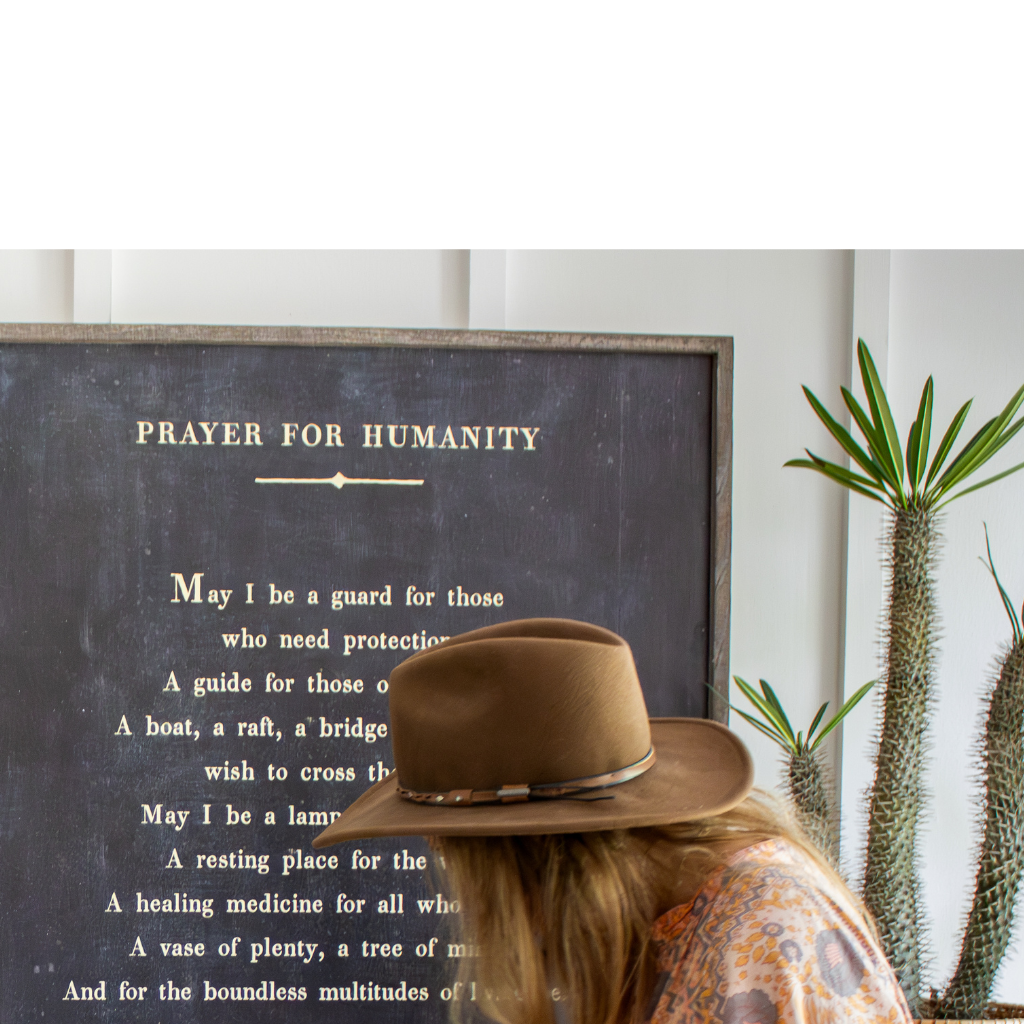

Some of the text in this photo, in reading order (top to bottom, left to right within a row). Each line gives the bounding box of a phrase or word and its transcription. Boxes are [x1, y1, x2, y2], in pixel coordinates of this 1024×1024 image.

[135, 420, 541, 451] PRAYER FOR HUMANITY
[169, 572, 504, 611] May I be a guard for those
[221, 626, 268, 649] who
[278, 628, 331, 650] need
[162, 670, 364, 698] A guide for those
[113, 714, 388, 744] A boat, a raft, a bridge
[203, 759, 255, 782] wish
[267, 763, 289, 782] to
[300, 766, 356, 782] cross
[140, 803, 191, 832] May
[201, 803, 212, 825] I
[225, 803, 252, 826] be
[264, 810, 277, 826] a
[164, 847, 184, 869] A
[196, 848, 270, 875] resting
[281, 848, 339, 876] place
[351, 849, 382, 870] for
[393, 849, 427, 871] the
[104, 891, 123, 913] A
[135, 891, 214, 919] healing
[225, 892, 323, 914] medicine
[335, 892, 366, 914] for
[377, 893, 405, 914] all
[128, 935, 148, 957] A
[159, 942, 206, 957] vase
[217, 936, 242, 957] of
[249, 936, 325, 964] plenty,
[337, 943, 350, 958] a
[361, 940, 403, 958] tree
[415, 937, 439, 958] of
[61, 979, 107, 1002] And
[118, 980, 148, 1001] for
[158, 980, 193, 1001] the
[202, 980, 308, 1002] boundless
[318, 980, 430, 1002] multitudes
[439, 980, 463, 1004] of
